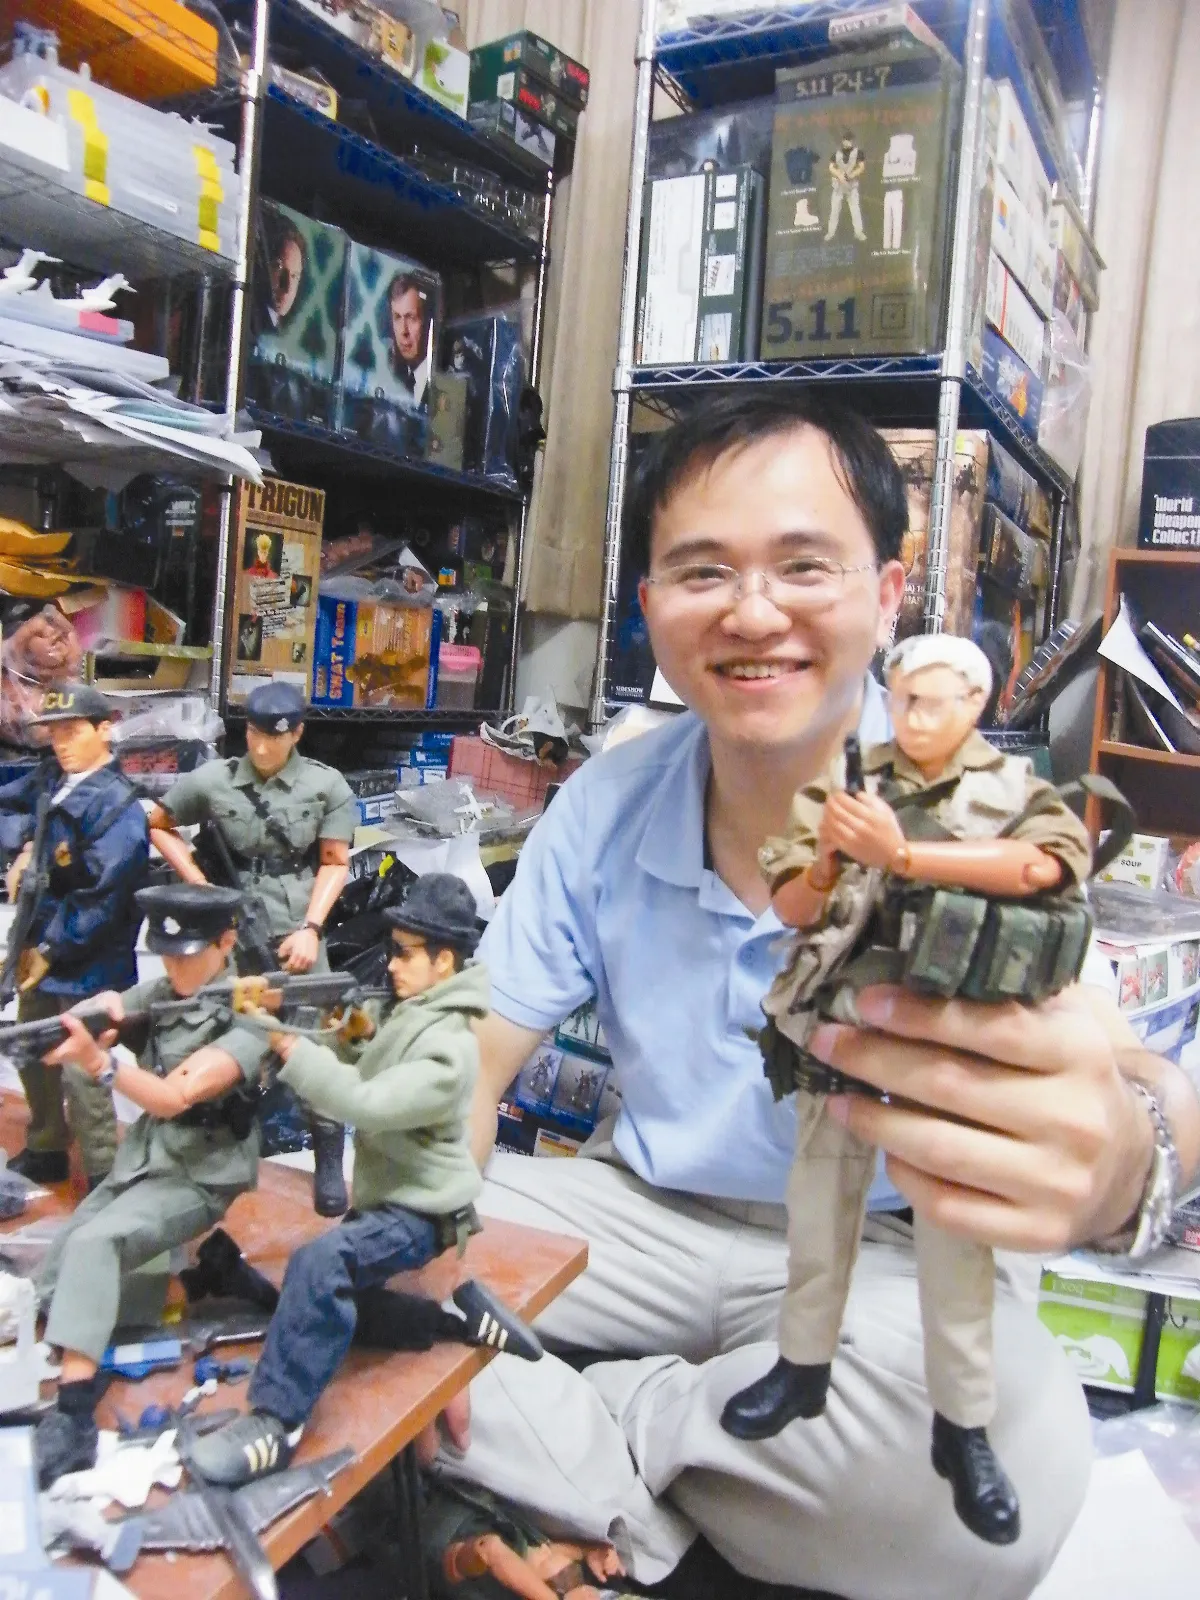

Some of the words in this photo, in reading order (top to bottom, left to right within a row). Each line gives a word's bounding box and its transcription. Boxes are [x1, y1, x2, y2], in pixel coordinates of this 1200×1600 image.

[832, 66, 891, 96] 24-7
[766, 297, 861, 343] 5.11
[244, 480, 324, 523] TRIGUN
[1155, 496, 1193, 512] World
[1120, 860, 1142, 868] SOUP
